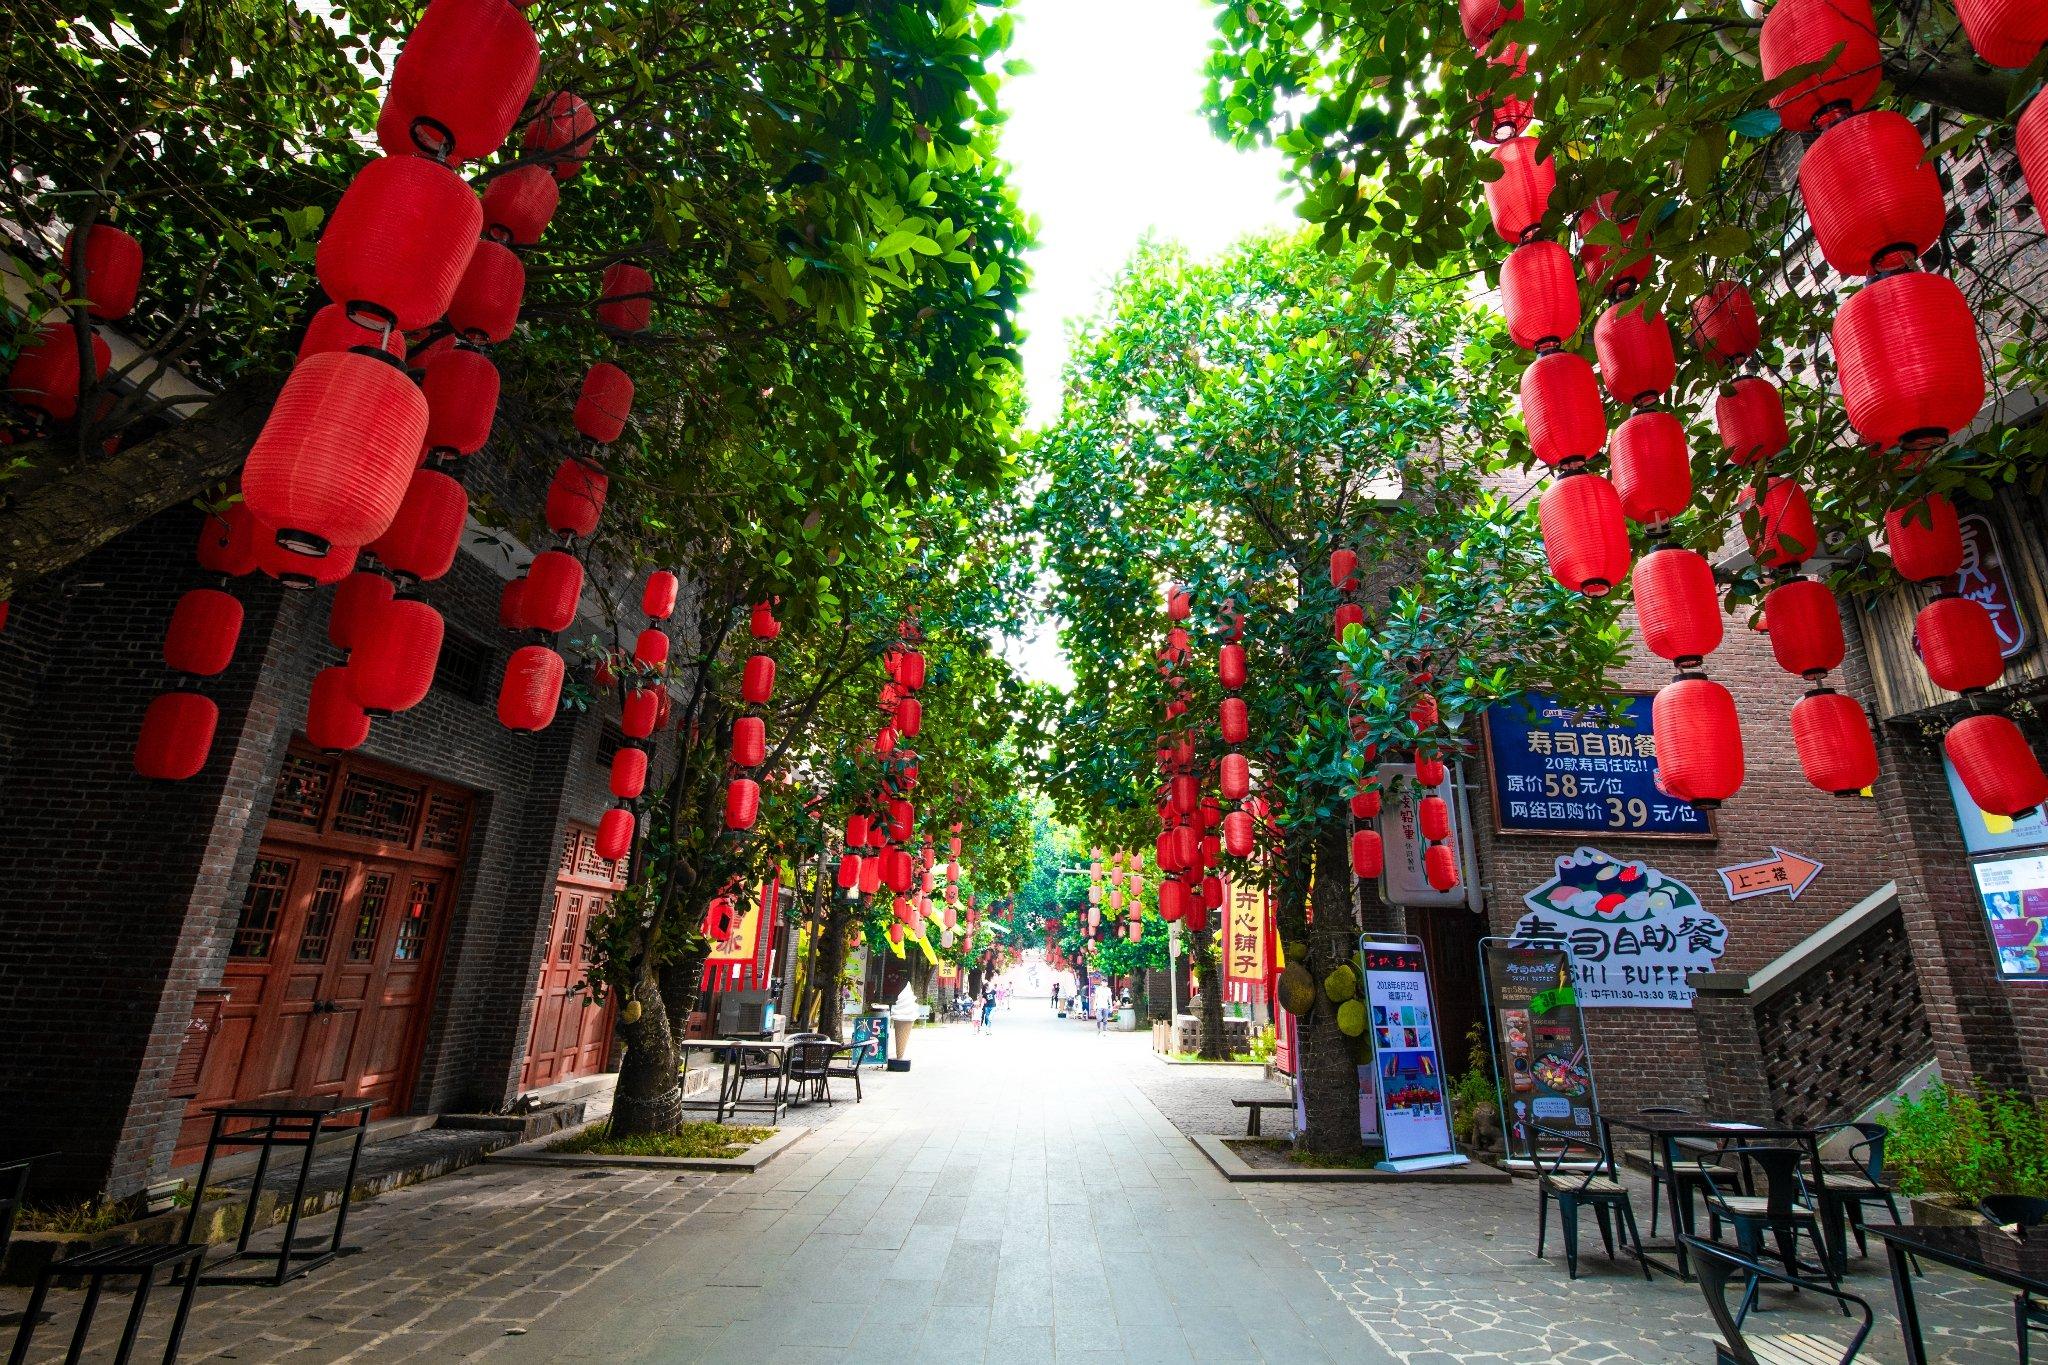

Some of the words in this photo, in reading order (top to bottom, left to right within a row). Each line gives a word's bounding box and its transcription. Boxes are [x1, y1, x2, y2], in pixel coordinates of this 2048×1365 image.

[1527, 731, 1657, 757] 寿司自助餐
[1545, 757, 1648, 773] 20款寿司任吃!!
[1739, 867, 1788, 888] 上二楼
[1235, 892, 1260, 974] 开心铺子
[1511, 914, 1725, 963] 寿司自助餐
[1377, 981, 1419, 991] 2018年6月22日
